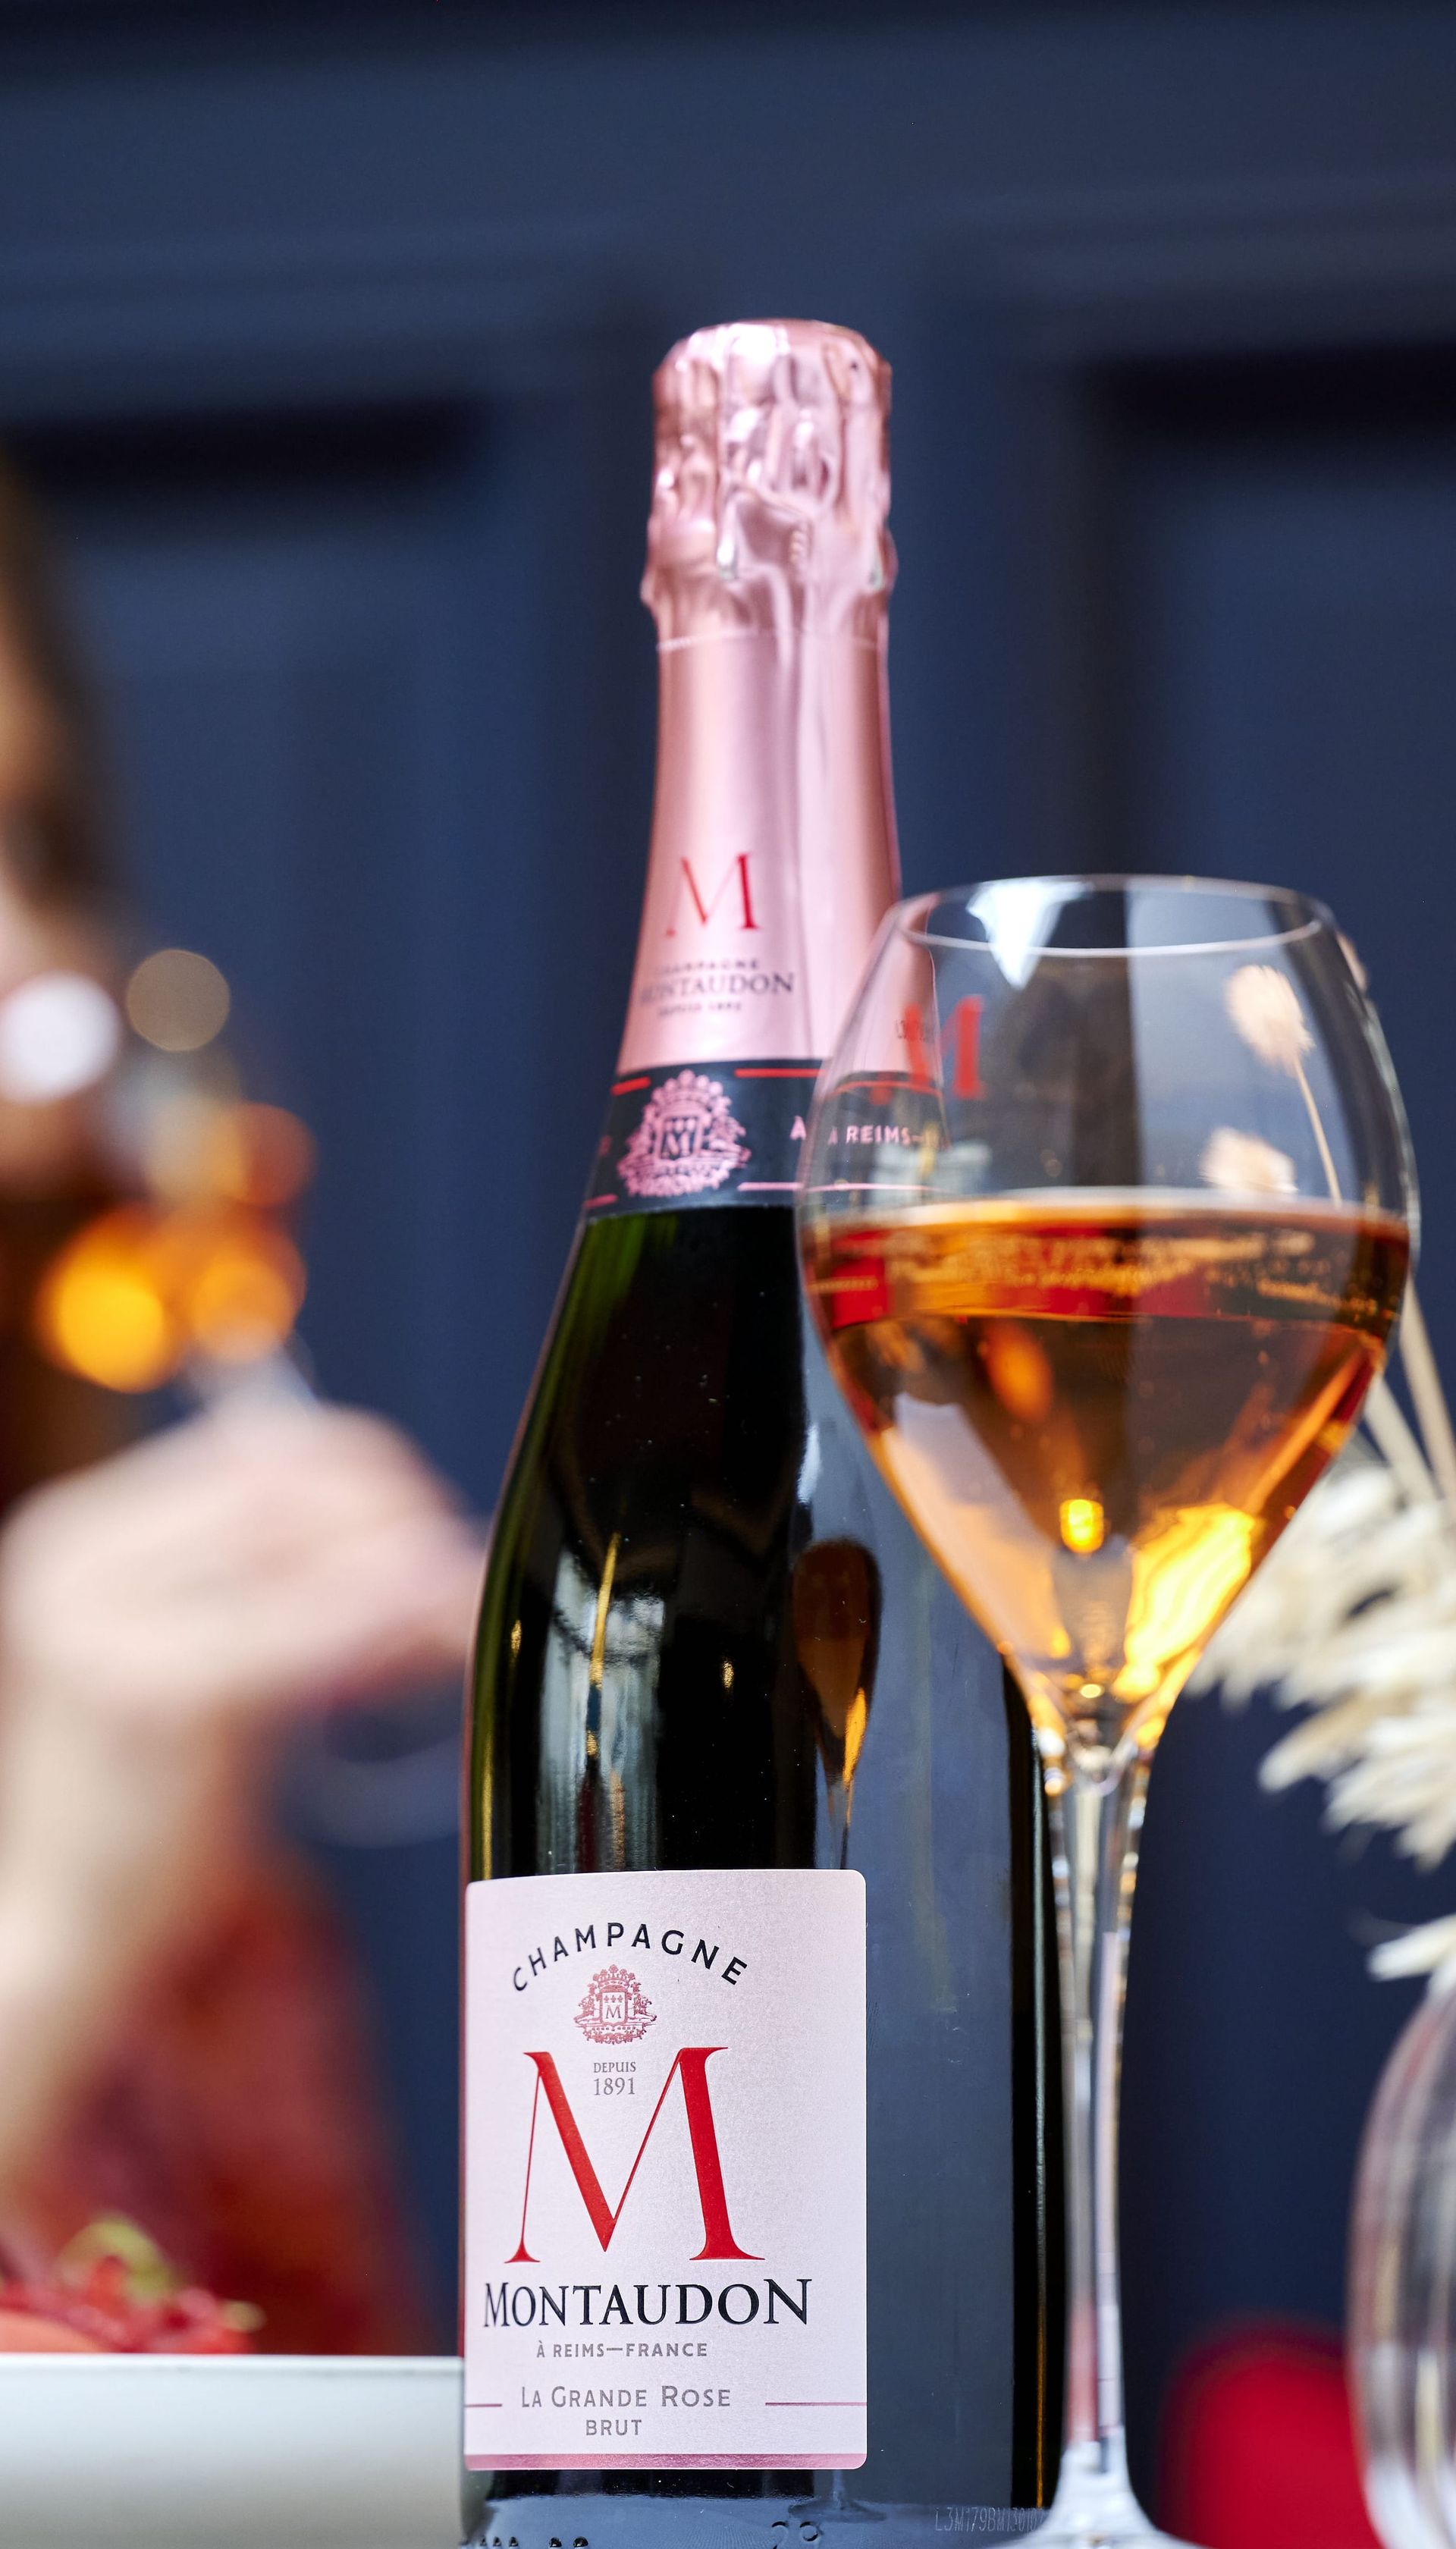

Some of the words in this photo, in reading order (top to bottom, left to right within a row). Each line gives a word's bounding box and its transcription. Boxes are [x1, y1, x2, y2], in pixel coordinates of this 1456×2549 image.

[663, 850, 764, 938] M
[513, 1922, 748, 1992] CHAMPAGNE
[605, 2004, 623, 2020] M
[593, 2061, 637, 2073] DEPUIS
[594, 2077, 635, 2095] 1891
[504, 2047, 766, 2264] M
[483, 2278, 813, 2328] MONTAUDON
[536, 2340, 546, 2359] À
[585, 2419, 642, 2436] BRUT
